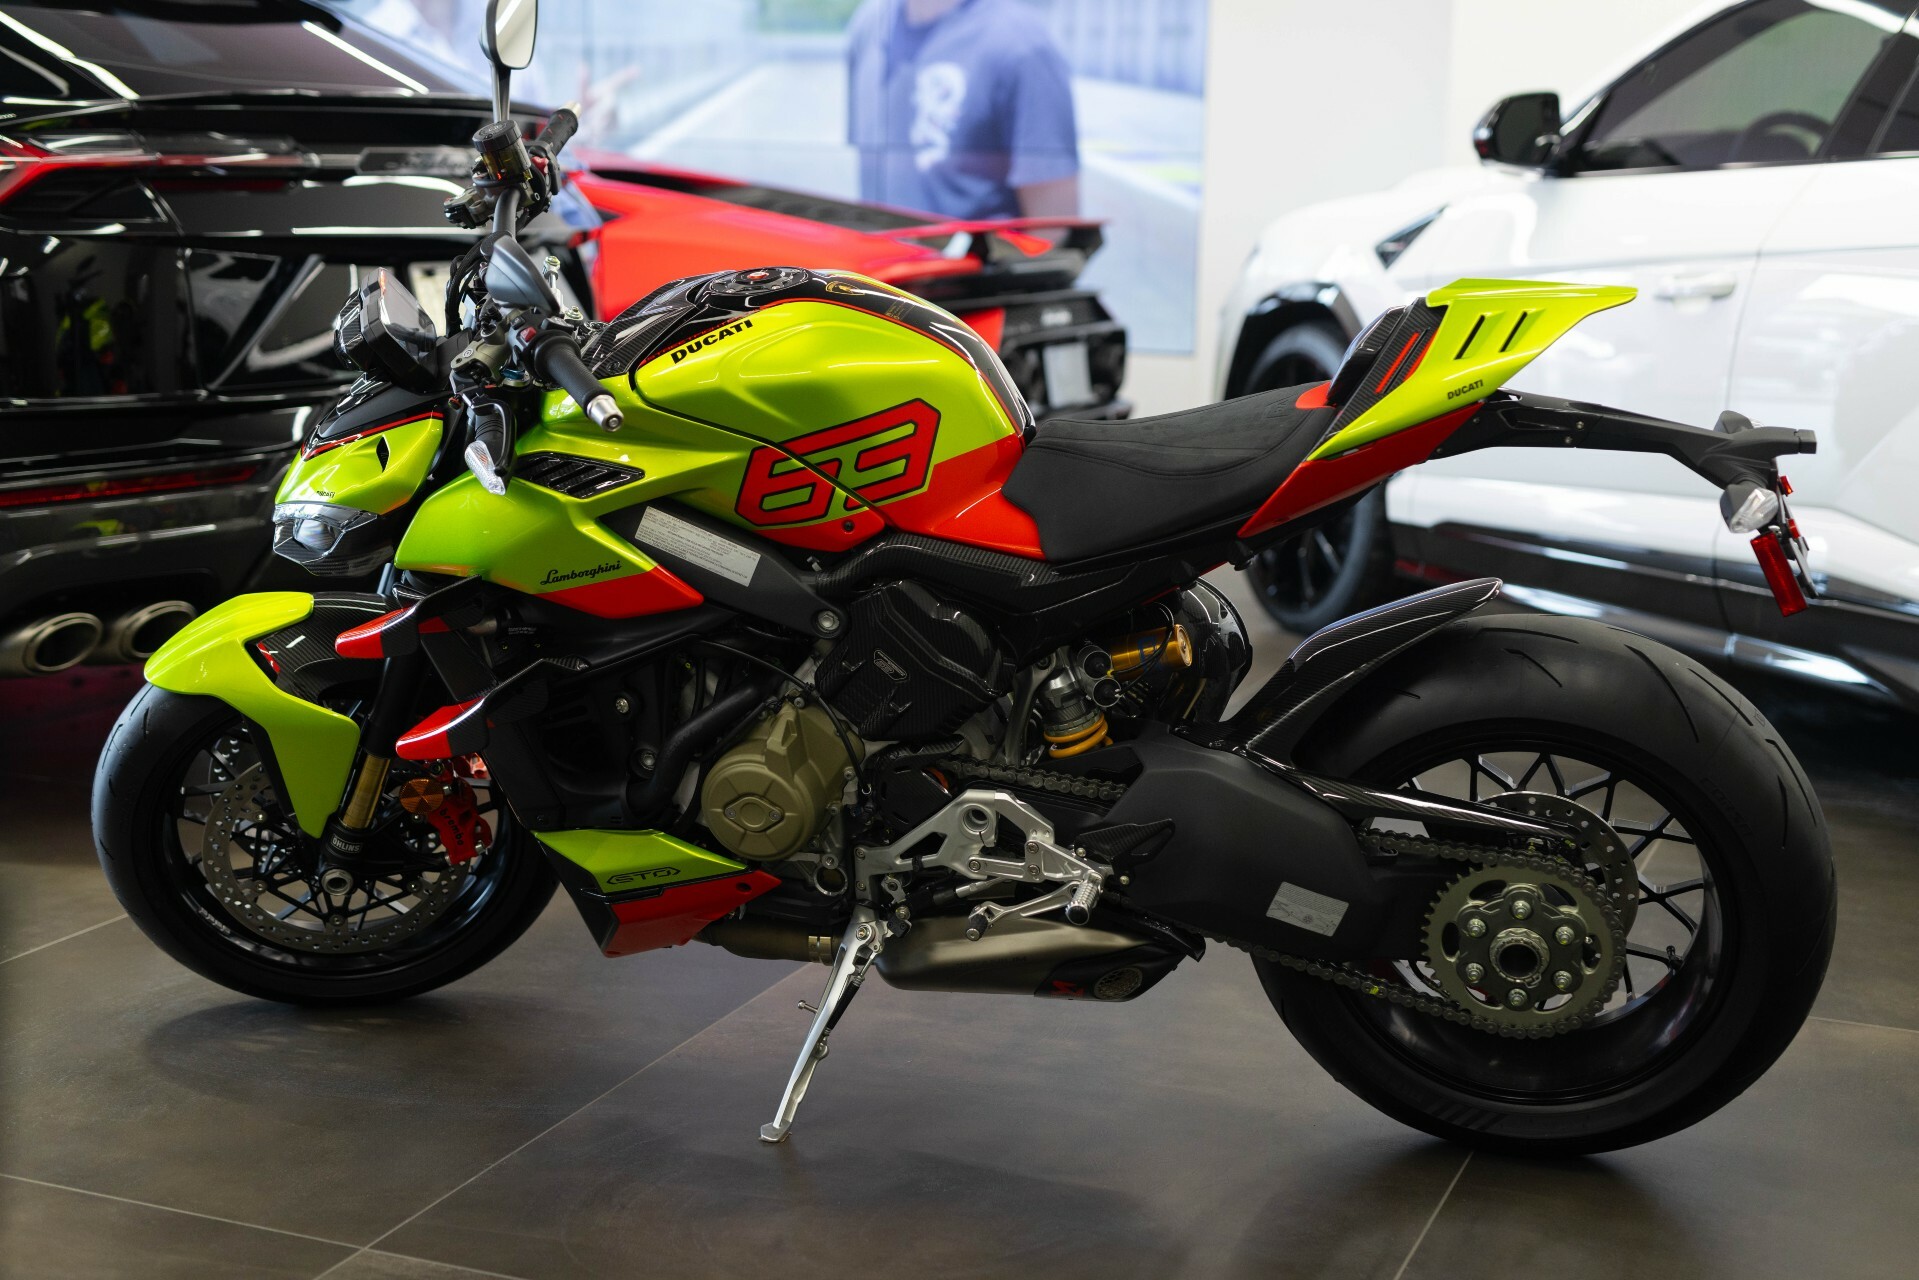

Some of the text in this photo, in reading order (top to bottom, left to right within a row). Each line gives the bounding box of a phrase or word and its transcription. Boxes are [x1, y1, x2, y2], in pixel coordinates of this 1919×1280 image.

[670, 319, 753, 365] DUCATI
[1447, 379, 1484, 400] DUCATI
[734, 397, 942, 527] 63
[540, 560, 622, 586] Lamborghini
[439, 807, 465, 846] brembo
